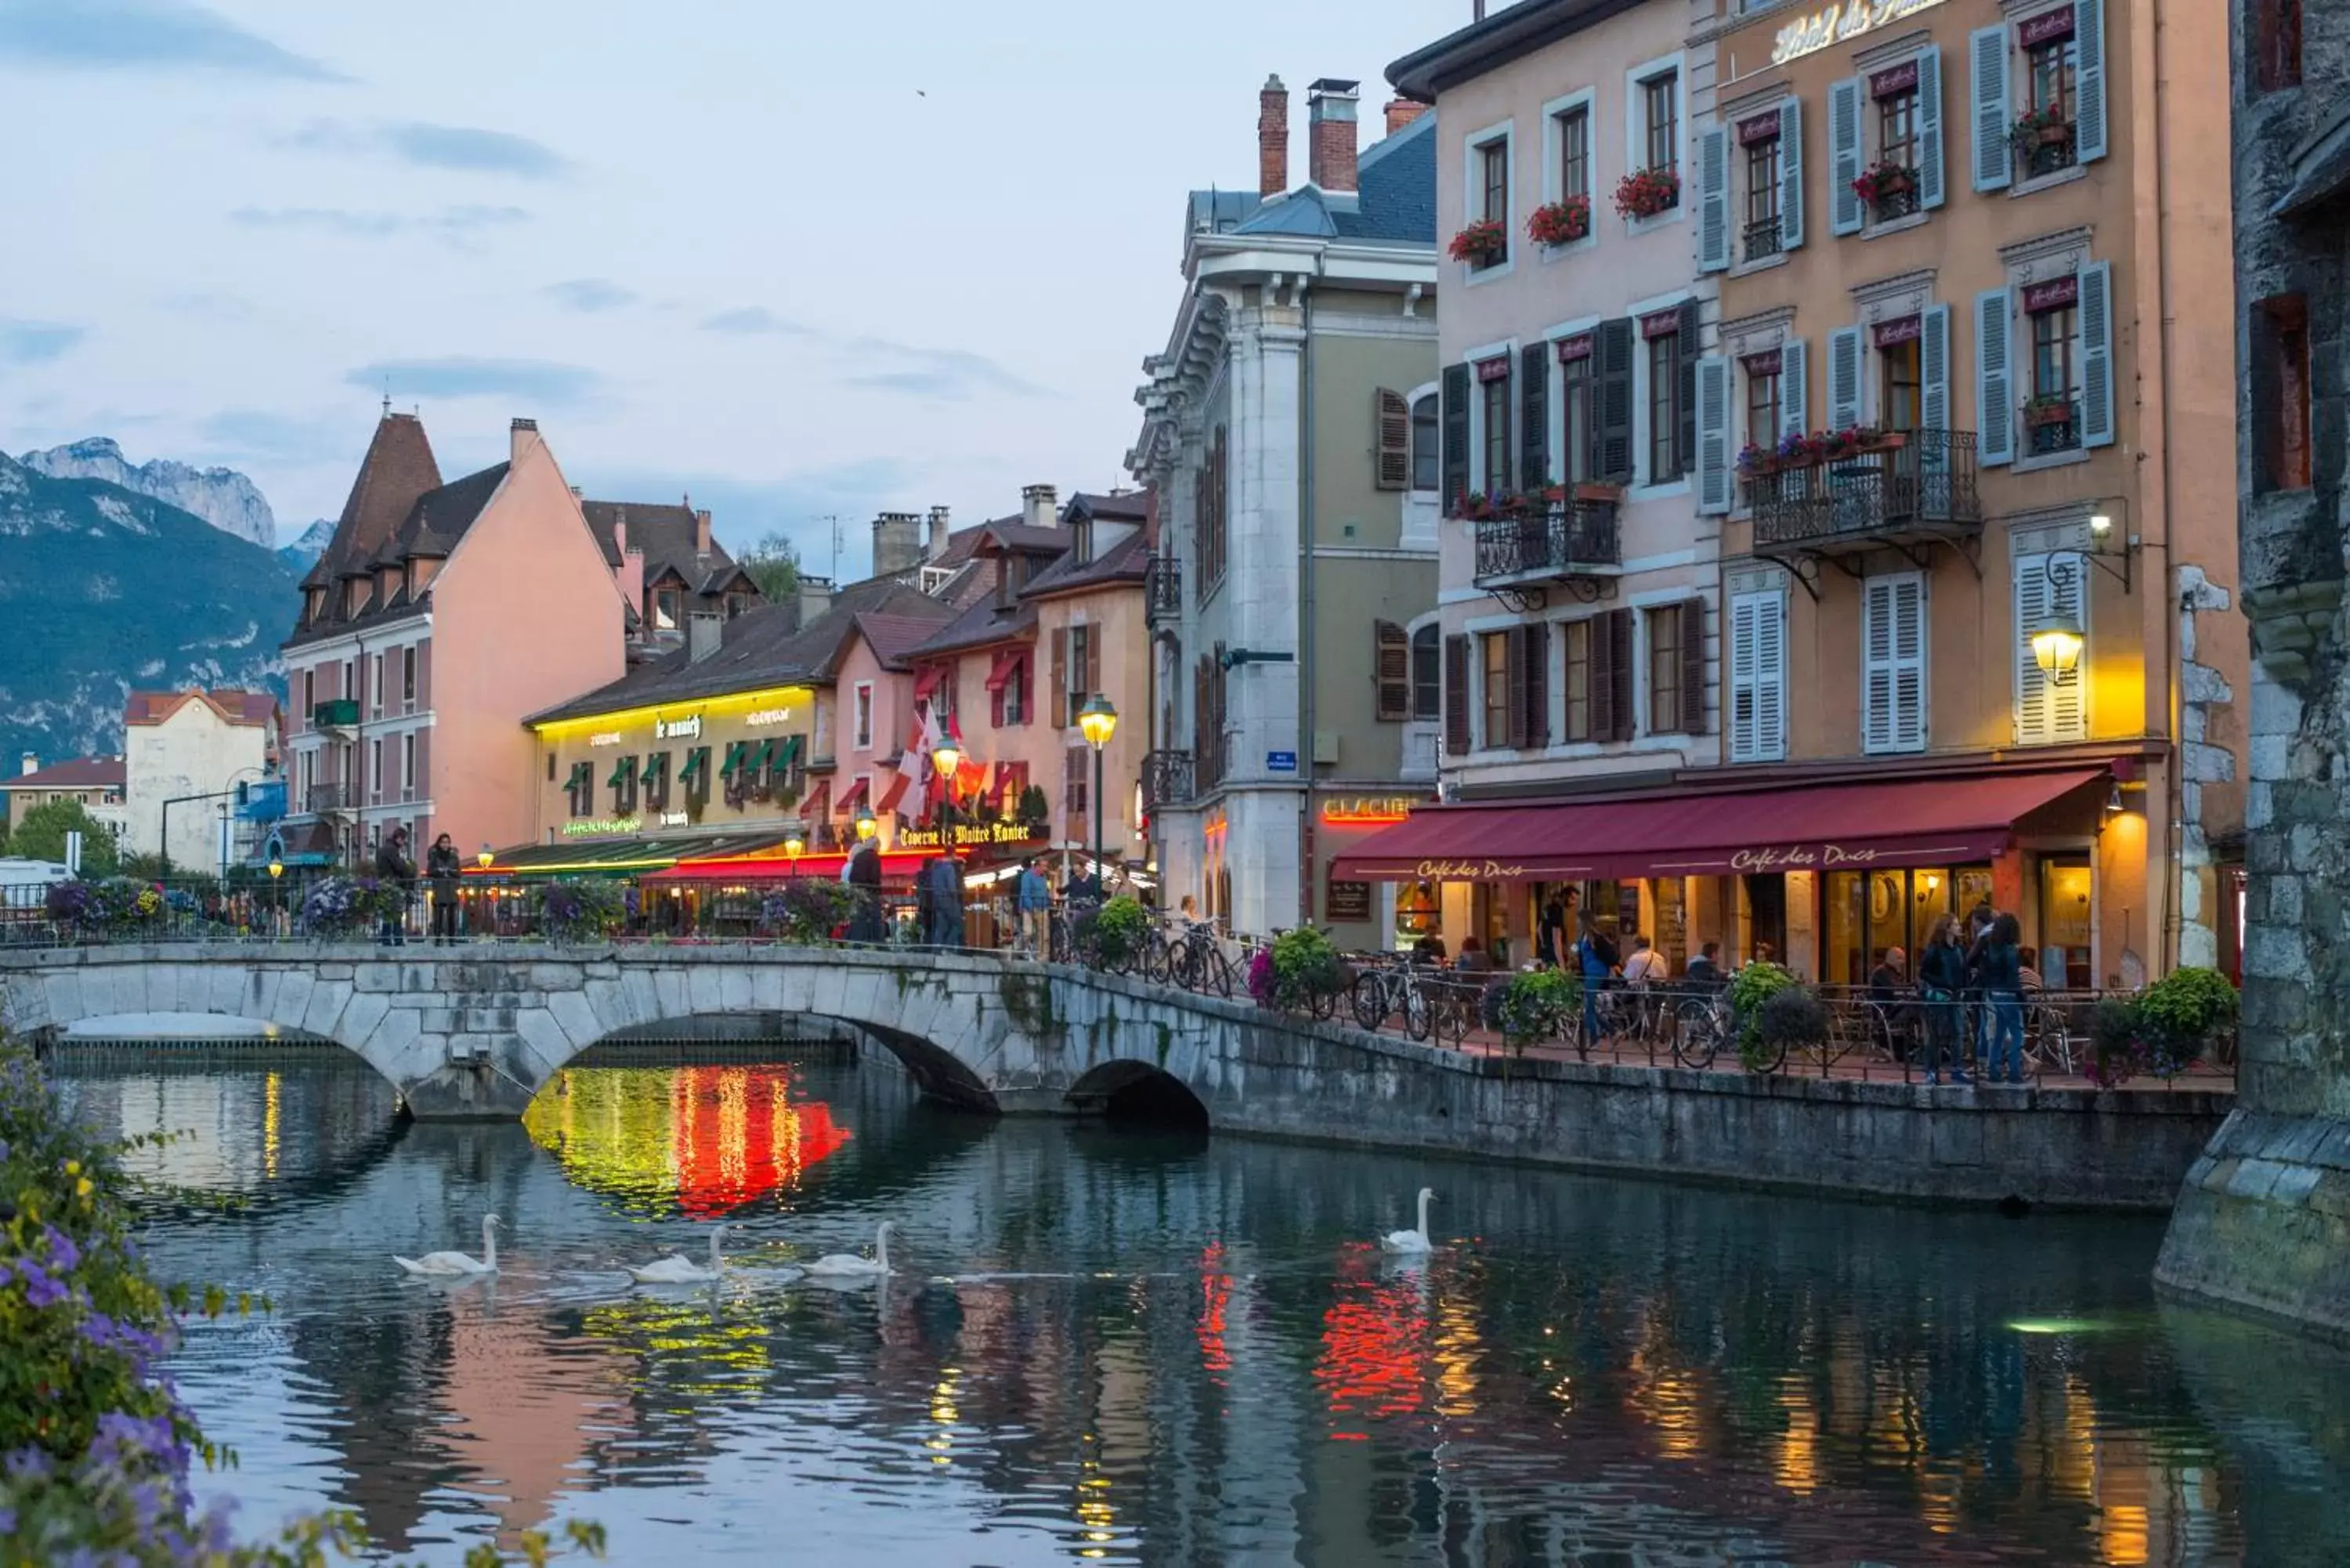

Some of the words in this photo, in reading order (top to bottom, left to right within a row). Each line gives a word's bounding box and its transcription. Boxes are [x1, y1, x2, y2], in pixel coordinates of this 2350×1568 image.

[1417, 859, 1454, 882] Café
[1452, 859, 1480, 876] des
[1483, 859, 1523, 878] Ducs
[1730, 847, 1780, 873] Café
[1778, 846, 1817, 865] des
[1823, 844, 1877, 865] Ducs
